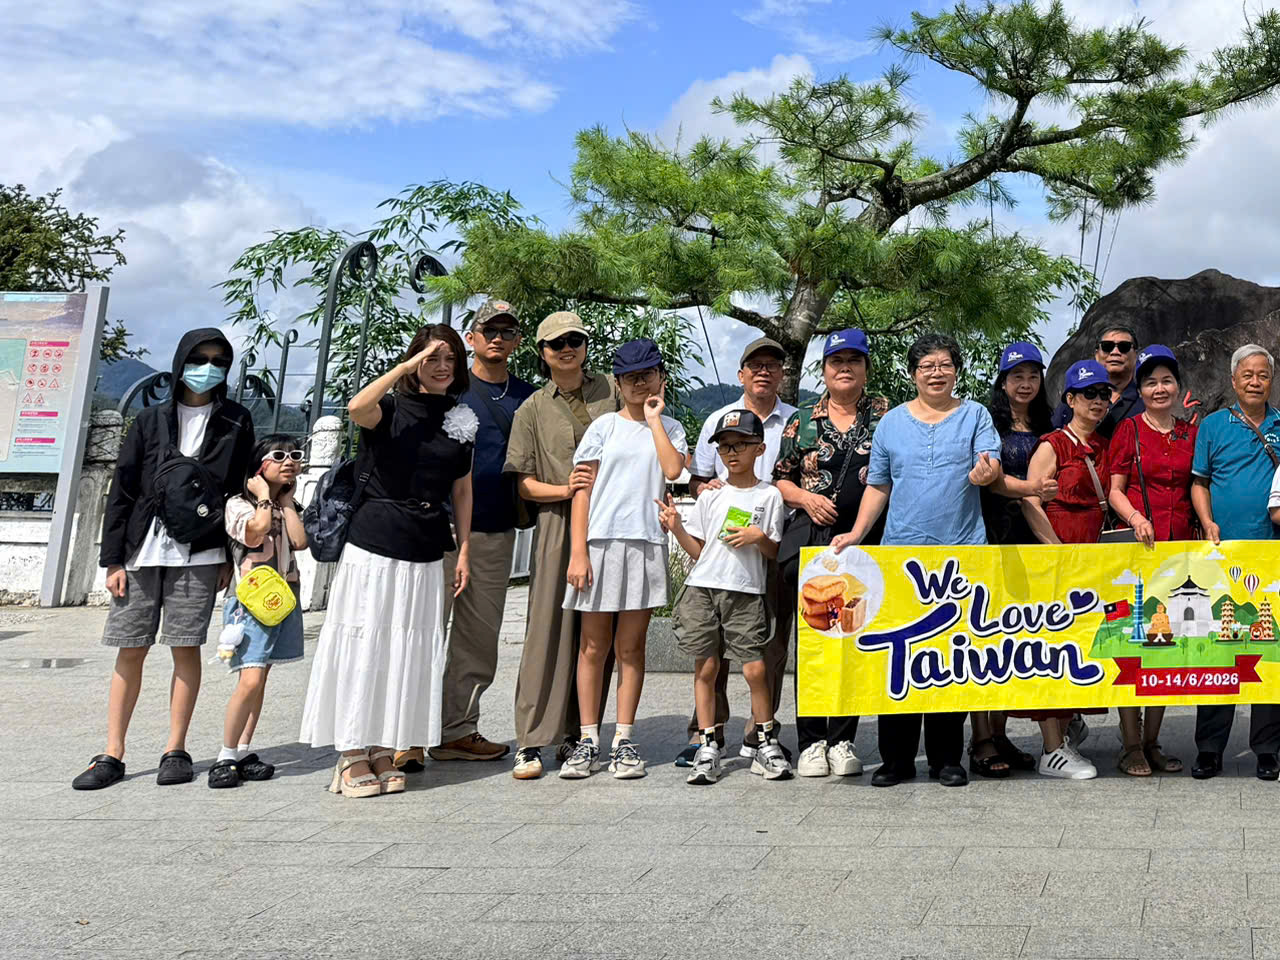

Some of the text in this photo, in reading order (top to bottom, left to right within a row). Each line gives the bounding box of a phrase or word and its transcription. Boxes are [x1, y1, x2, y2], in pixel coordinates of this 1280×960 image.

[905, 559, 970, 602] We
[969, 585, 1073, 635] Love
[857, 602, 1102, 696] Taiwan
[1141, 672, 1239, 687] 10-14/6/2026
